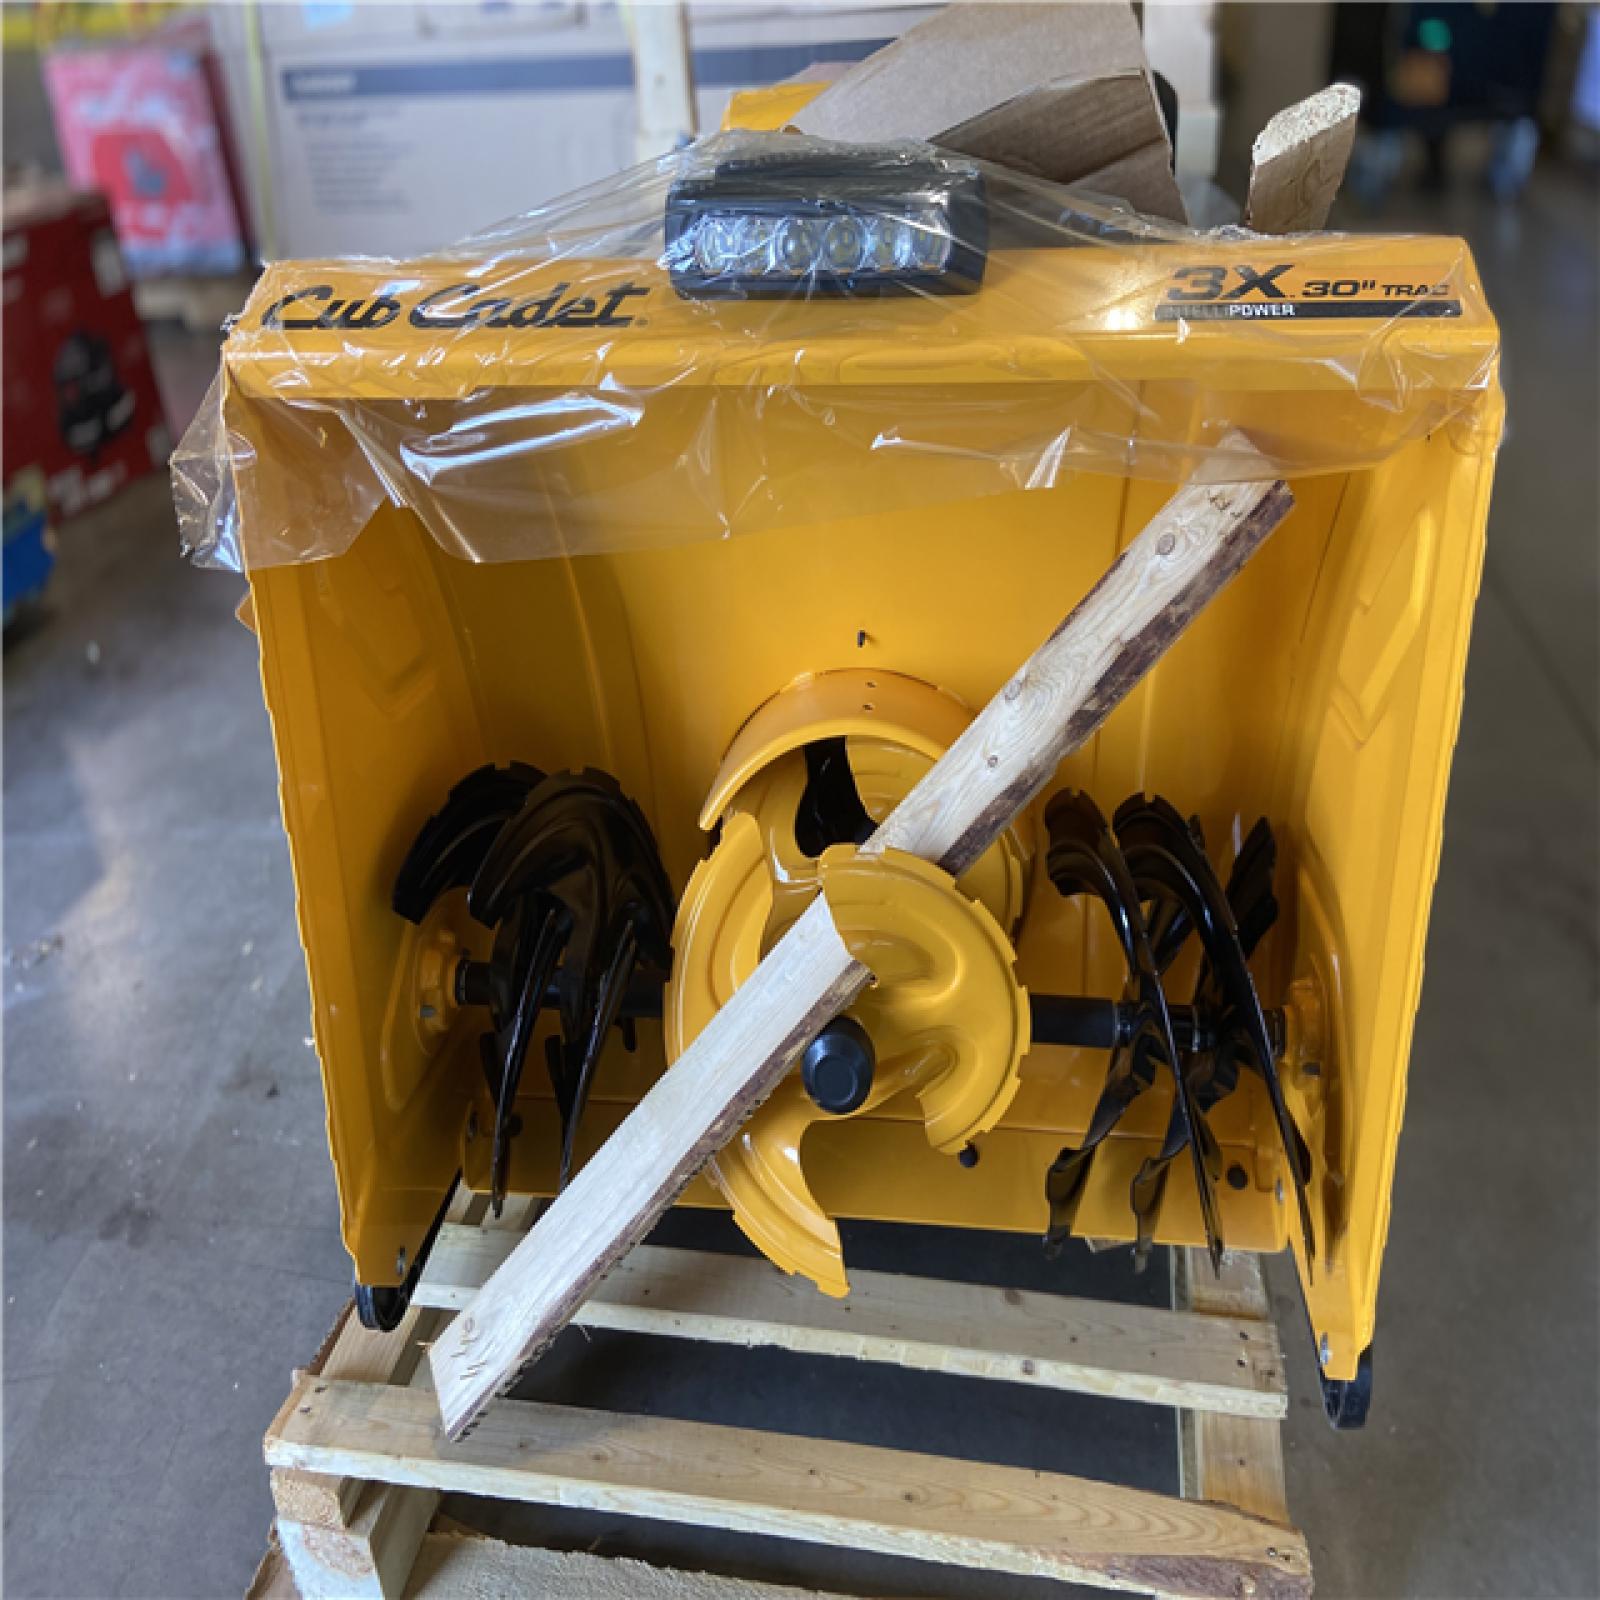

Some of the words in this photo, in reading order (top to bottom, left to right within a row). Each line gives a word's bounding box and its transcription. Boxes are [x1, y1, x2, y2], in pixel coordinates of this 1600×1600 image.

[1166, 264, 1294, 301] 3X
[1301, 279, 1376, 297] 30"
[262, 284, 400, 329] Cub
[409, 282, 649, 328] Cadet
